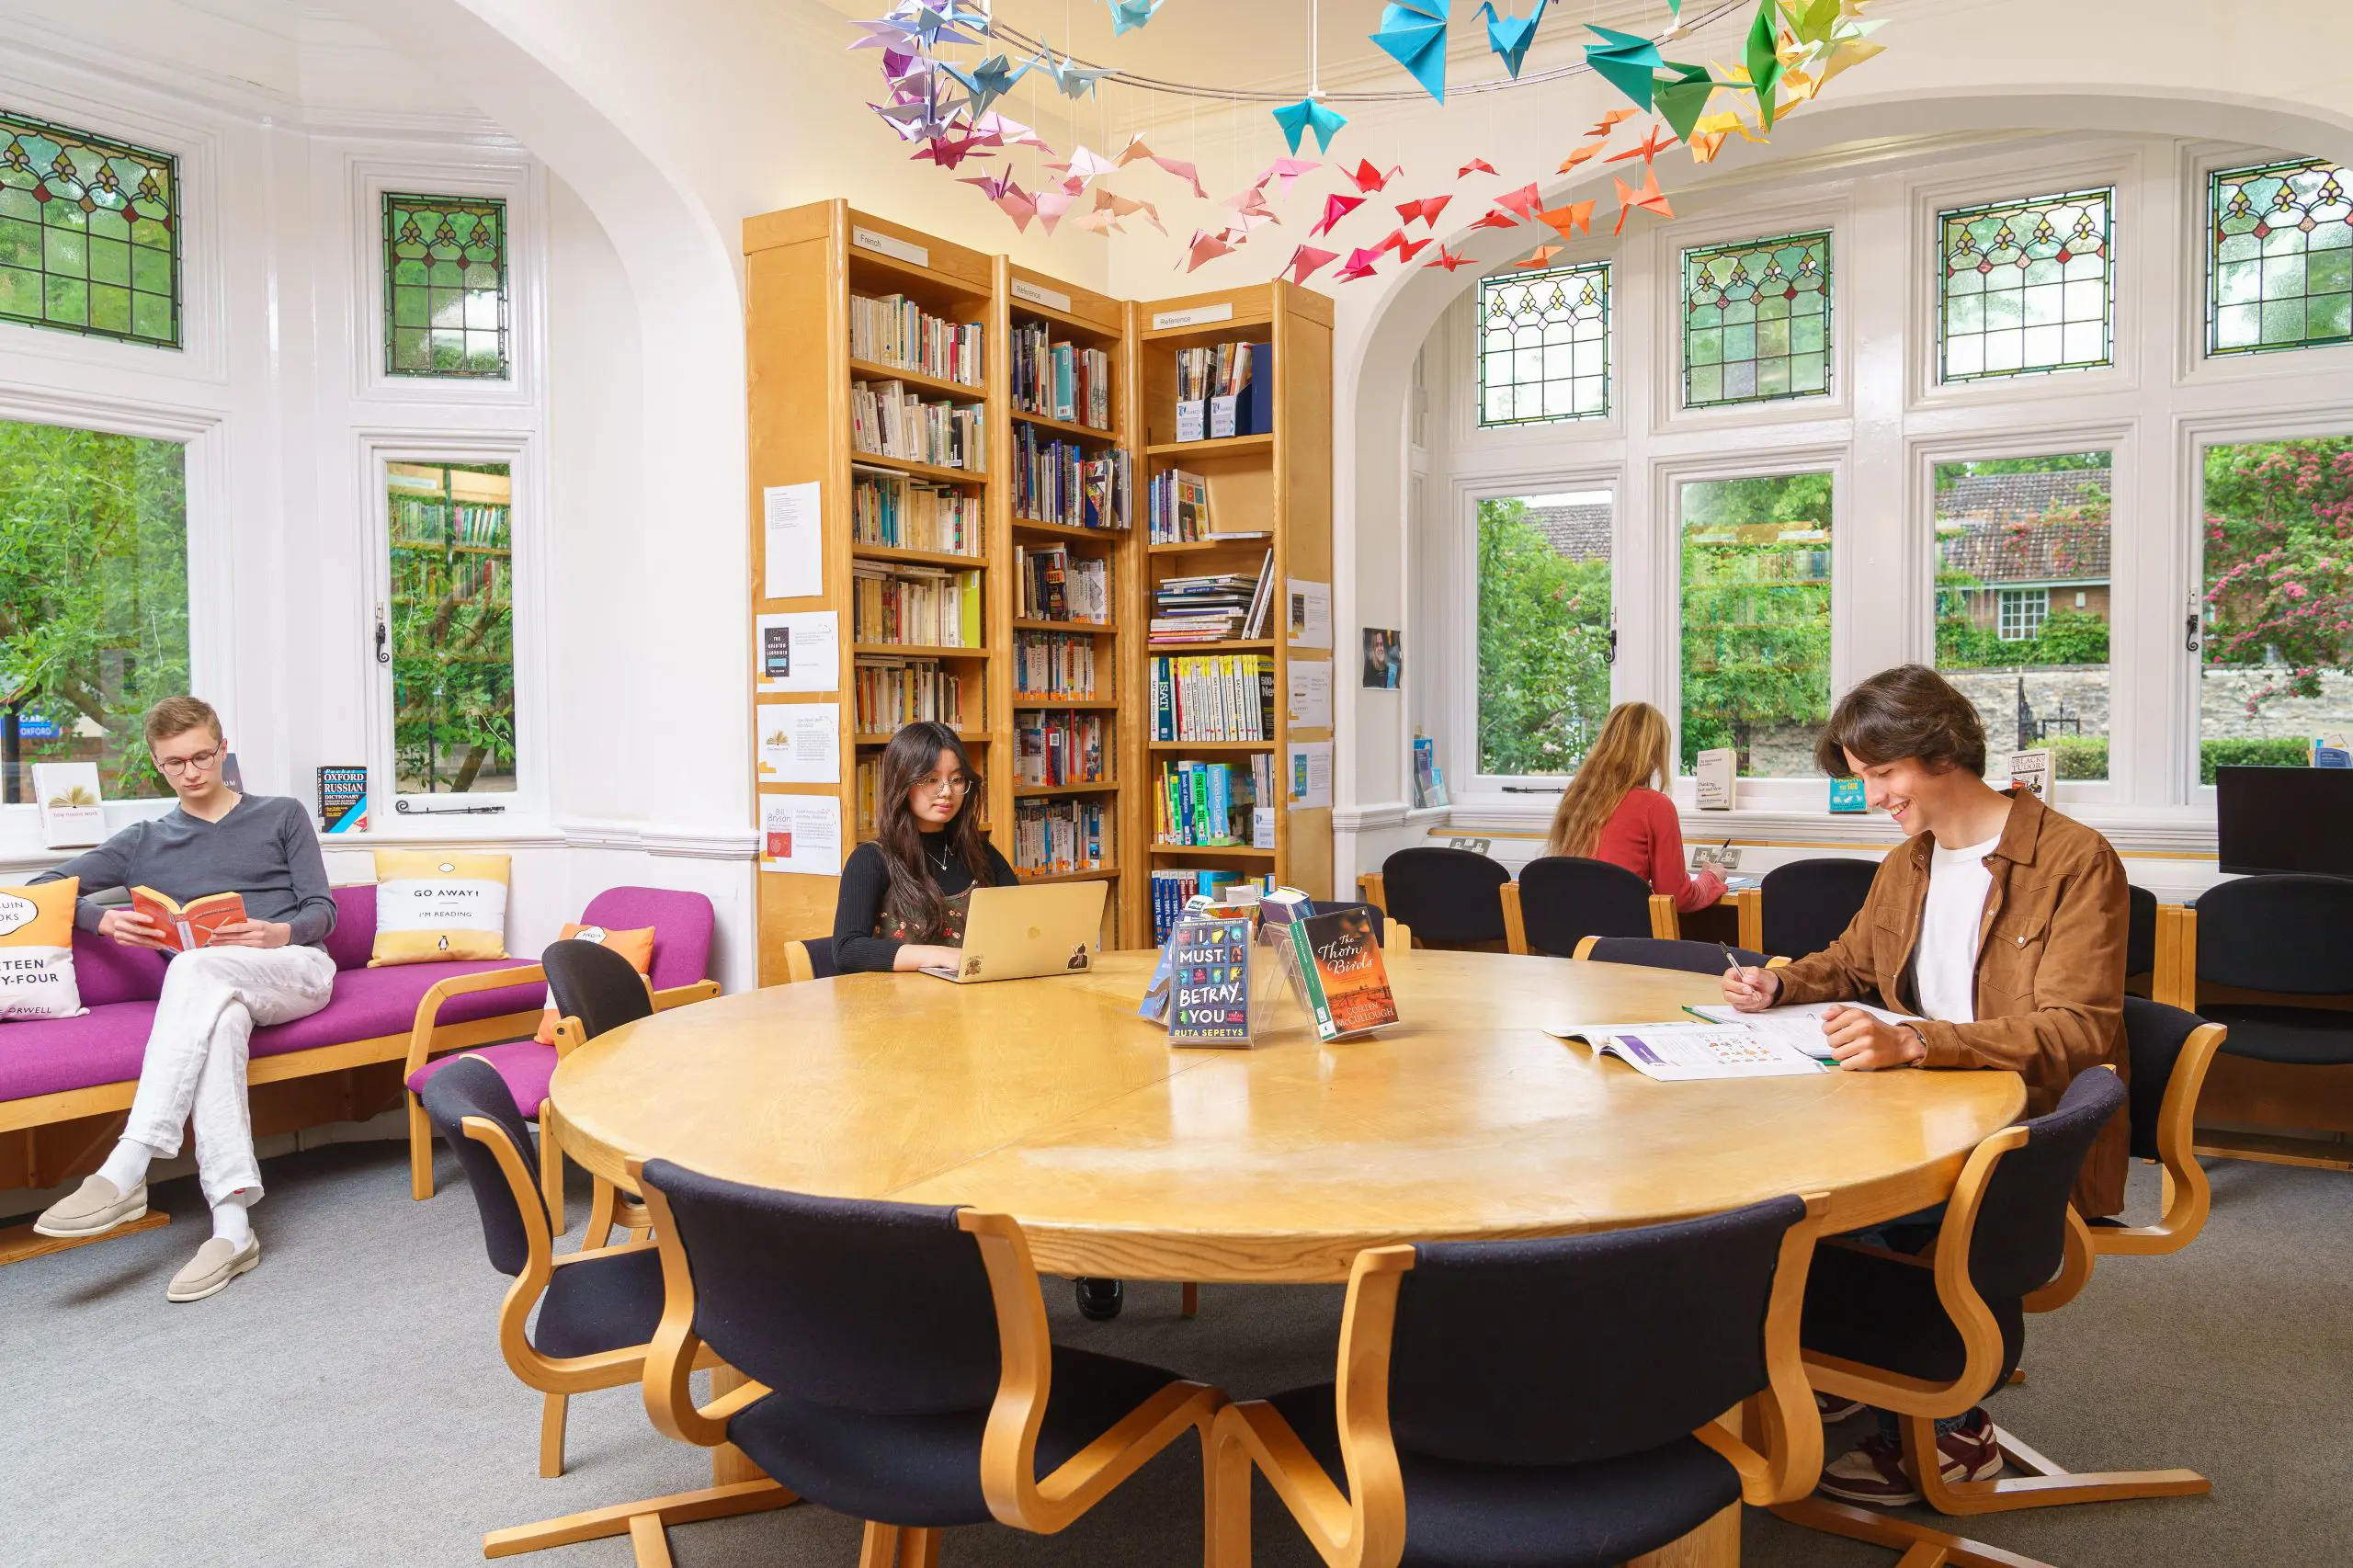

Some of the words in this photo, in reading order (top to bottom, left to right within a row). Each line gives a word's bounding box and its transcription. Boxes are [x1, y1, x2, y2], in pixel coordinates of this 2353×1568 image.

[860, 233, 881, 248] French
[1017, 285, 1041, 300] Reference
[1160, 316, 1191, 325] Reference
[1159, 685, 1168, 708] SAT
[20, 727, 51, 735] OXFORD
[2013, 762, 2045, 771] TUDORS
[324, 783, 363, 792] RUSSIAN
[1195, 773, 1204, 790] FISKE
[1196, 790, 1205, 806] GUIDE
[768, 812, 791, 823] Bryson
[414, 889, 433, 897] GO
[438, 889, 479, 897] AWAY!
[1199, 929, 1203, 942] I
[1339, 934, 1355, 944] The
[1179, 949, 1223, 962] MUST
[1318, 941, 1363, 961] Thorn
[1326, 952, 1374, 975] Birds
[1179, 982, 1239, 1007] BETRAY
[1347, 1002, 1379, 1015] COLLEEN
[1188, 1009, 1224, 1023] YOU
